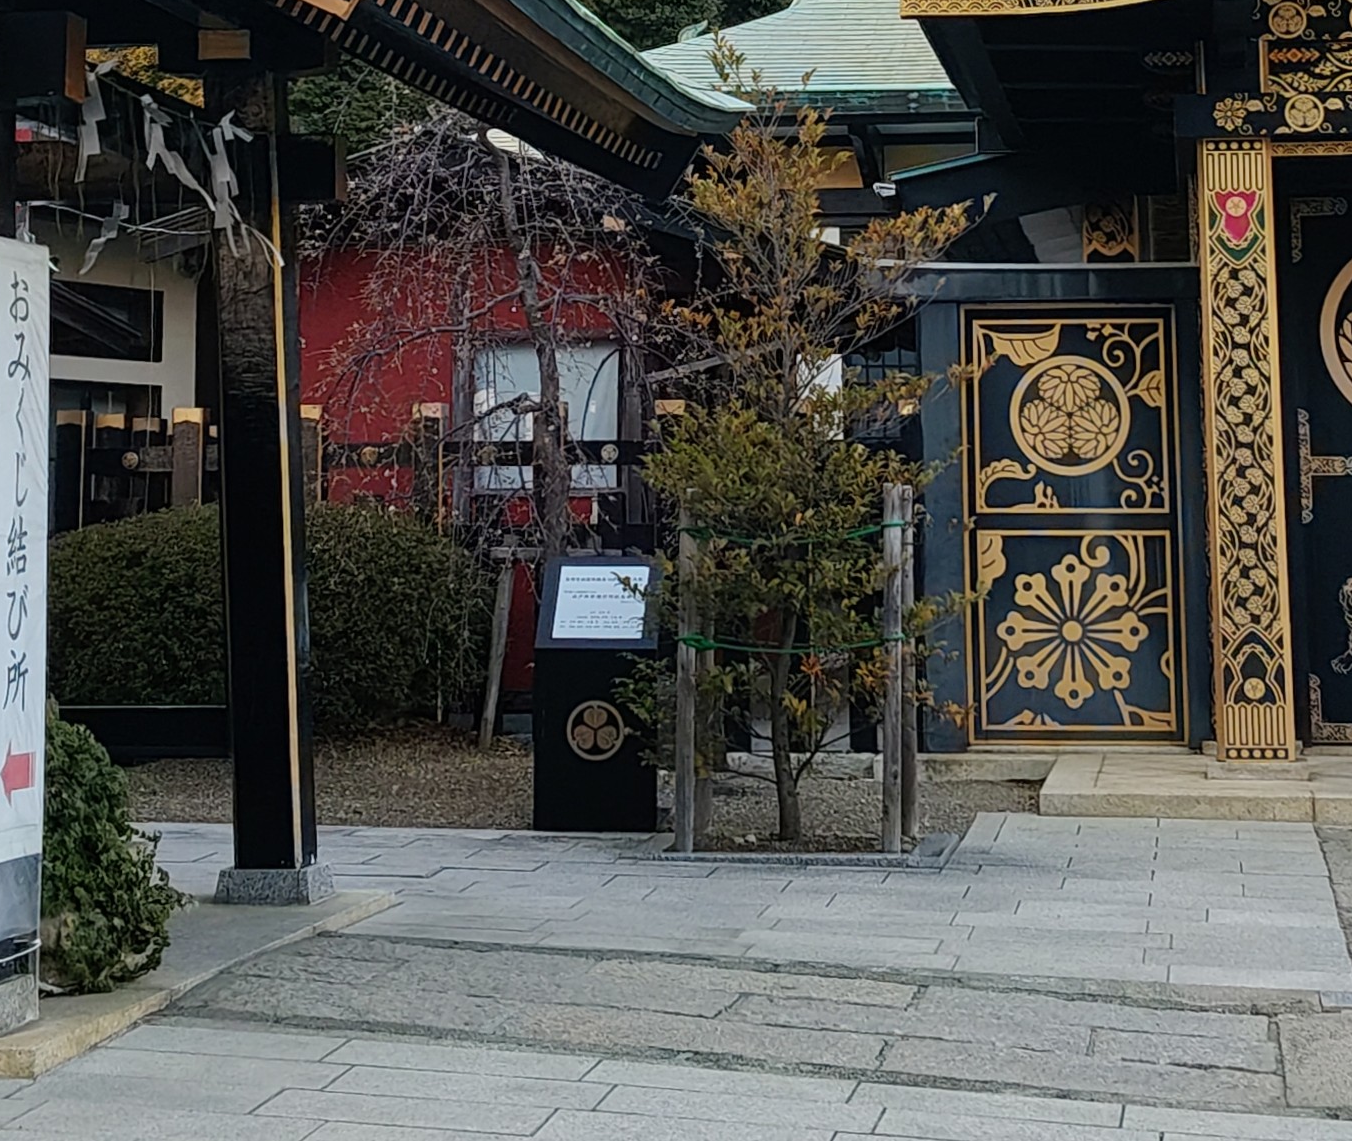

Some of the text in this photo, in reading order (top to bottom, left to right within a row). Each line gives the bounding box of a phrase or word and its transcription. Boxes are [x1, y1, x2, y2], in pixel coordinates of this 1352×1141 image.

[2, 270, 32, 712] おみくじ結び所
